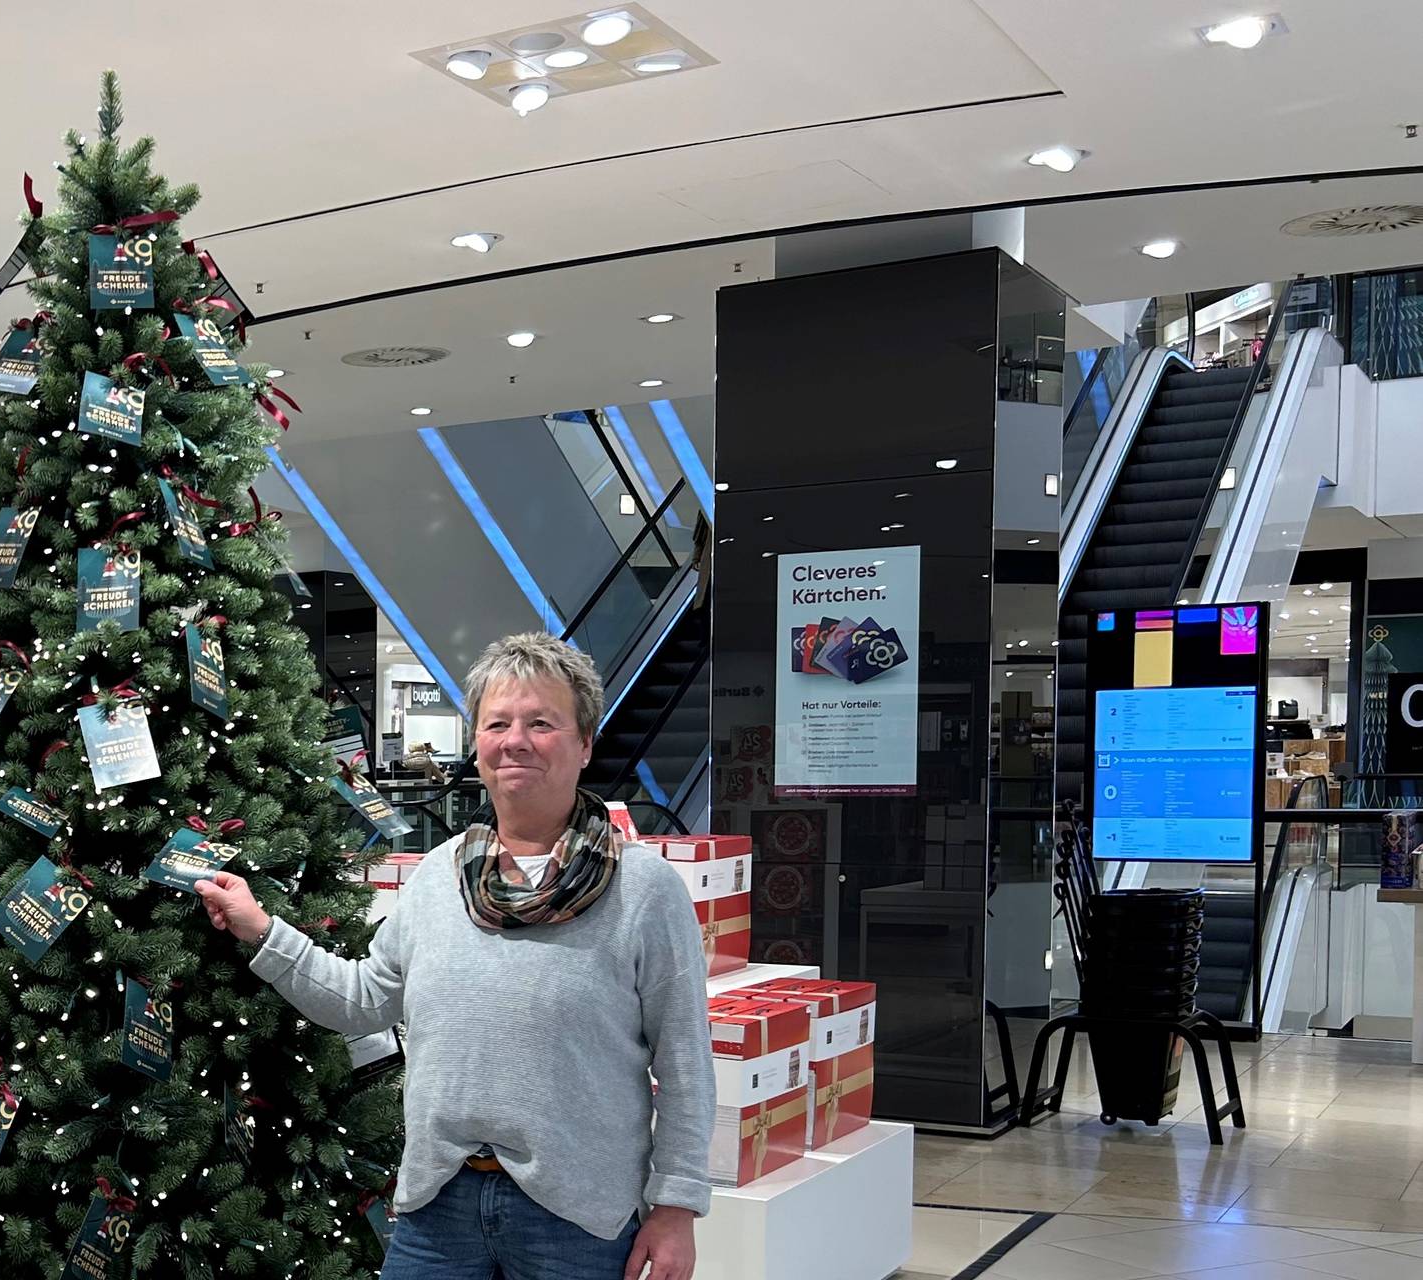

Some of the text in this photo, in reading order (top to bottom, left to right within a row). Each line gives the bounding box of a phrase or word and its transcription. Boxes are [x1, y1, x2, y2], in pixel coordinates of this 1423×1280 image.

[96, 282, 148, 290] SCHENKEN
[103, 274, 141, 282] FREUDE
[0, 361, 36, 371] FREUDE
[85, 411, 137, 432] SCHENKEN
[92, 408, 130, 425] FREUDE
[792, 564, 877, 582] Cleveres
[90, 590, 128, 602] FREUDE
[792, 586, 887, 605] Kärtchen.
[83, 599, 135, 612] SCHENKEN
[412, 686, 441, 706] bugatti
[802, 701, 819, 710] Hat
[840, 700, 882, 709] Vorteile:
[1110, 708, 1117, 716] 2
[96, 749, 145, 766] SCHENKE
[101, 742, 139, 756] FREUDE
[1104, 785, 1117, 800] 0
[172, 853, 210, 868] FREUDE
[7, 900, 52, 941] SCHENKEN
[19, 898, 52, 930] FREUDE
[134, 1026, 163, 1048] FREUDE
[128, 1033, 169, 1060] SCHENKEN
[80, 1248, 108, 1269] FREUDE
[72, 1255, 108, 1280] SCHENKEN
